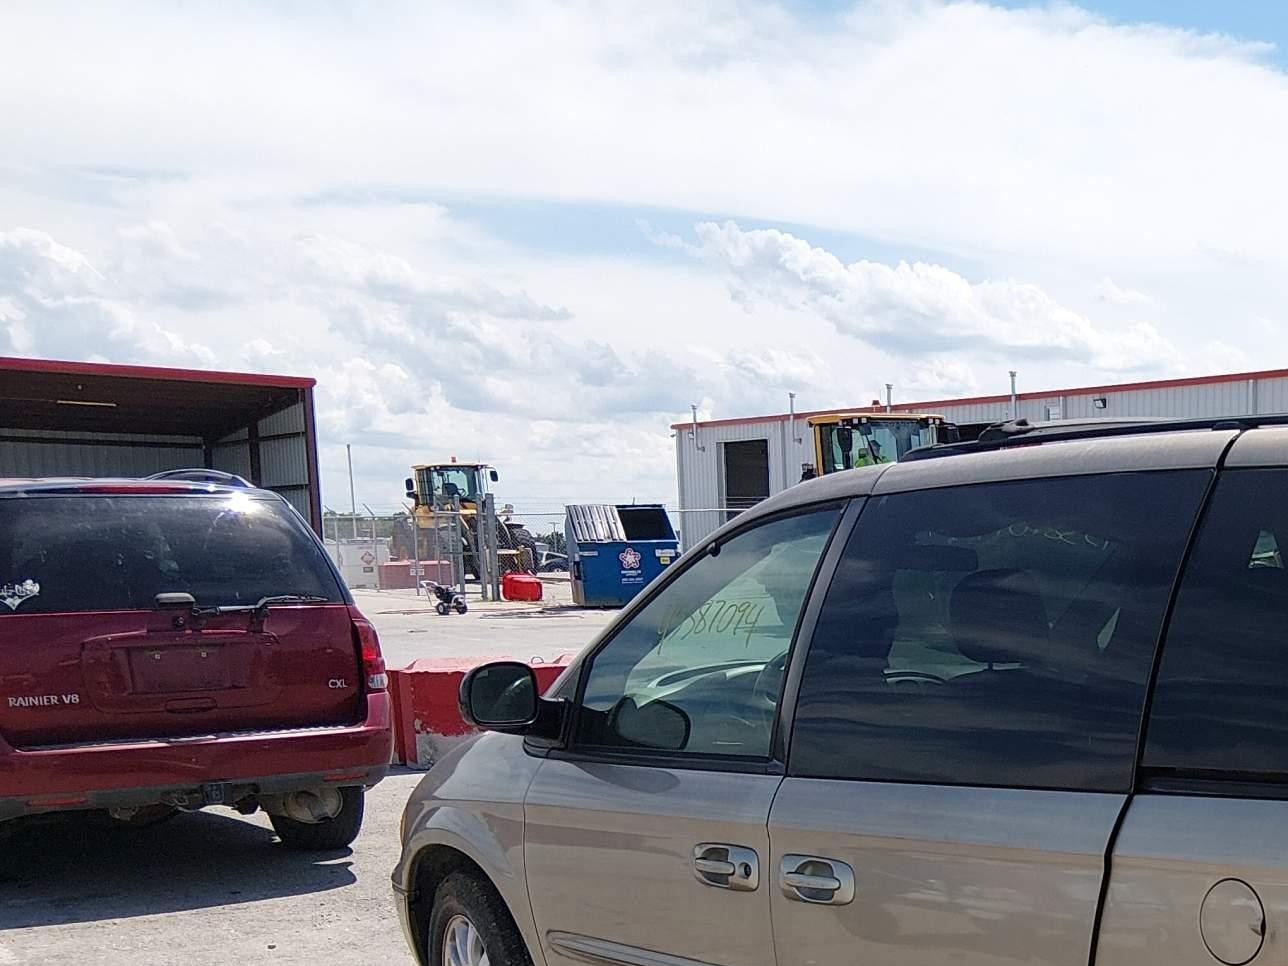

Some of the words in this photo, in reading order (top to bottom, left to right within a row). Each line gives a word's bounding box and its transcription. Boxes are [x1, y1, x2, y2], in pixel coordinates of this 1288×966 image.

[328, 679, 348, 689] CXL
[8, 695, 59, 708] RAINIER
[62, 694, 80, 705] V8
